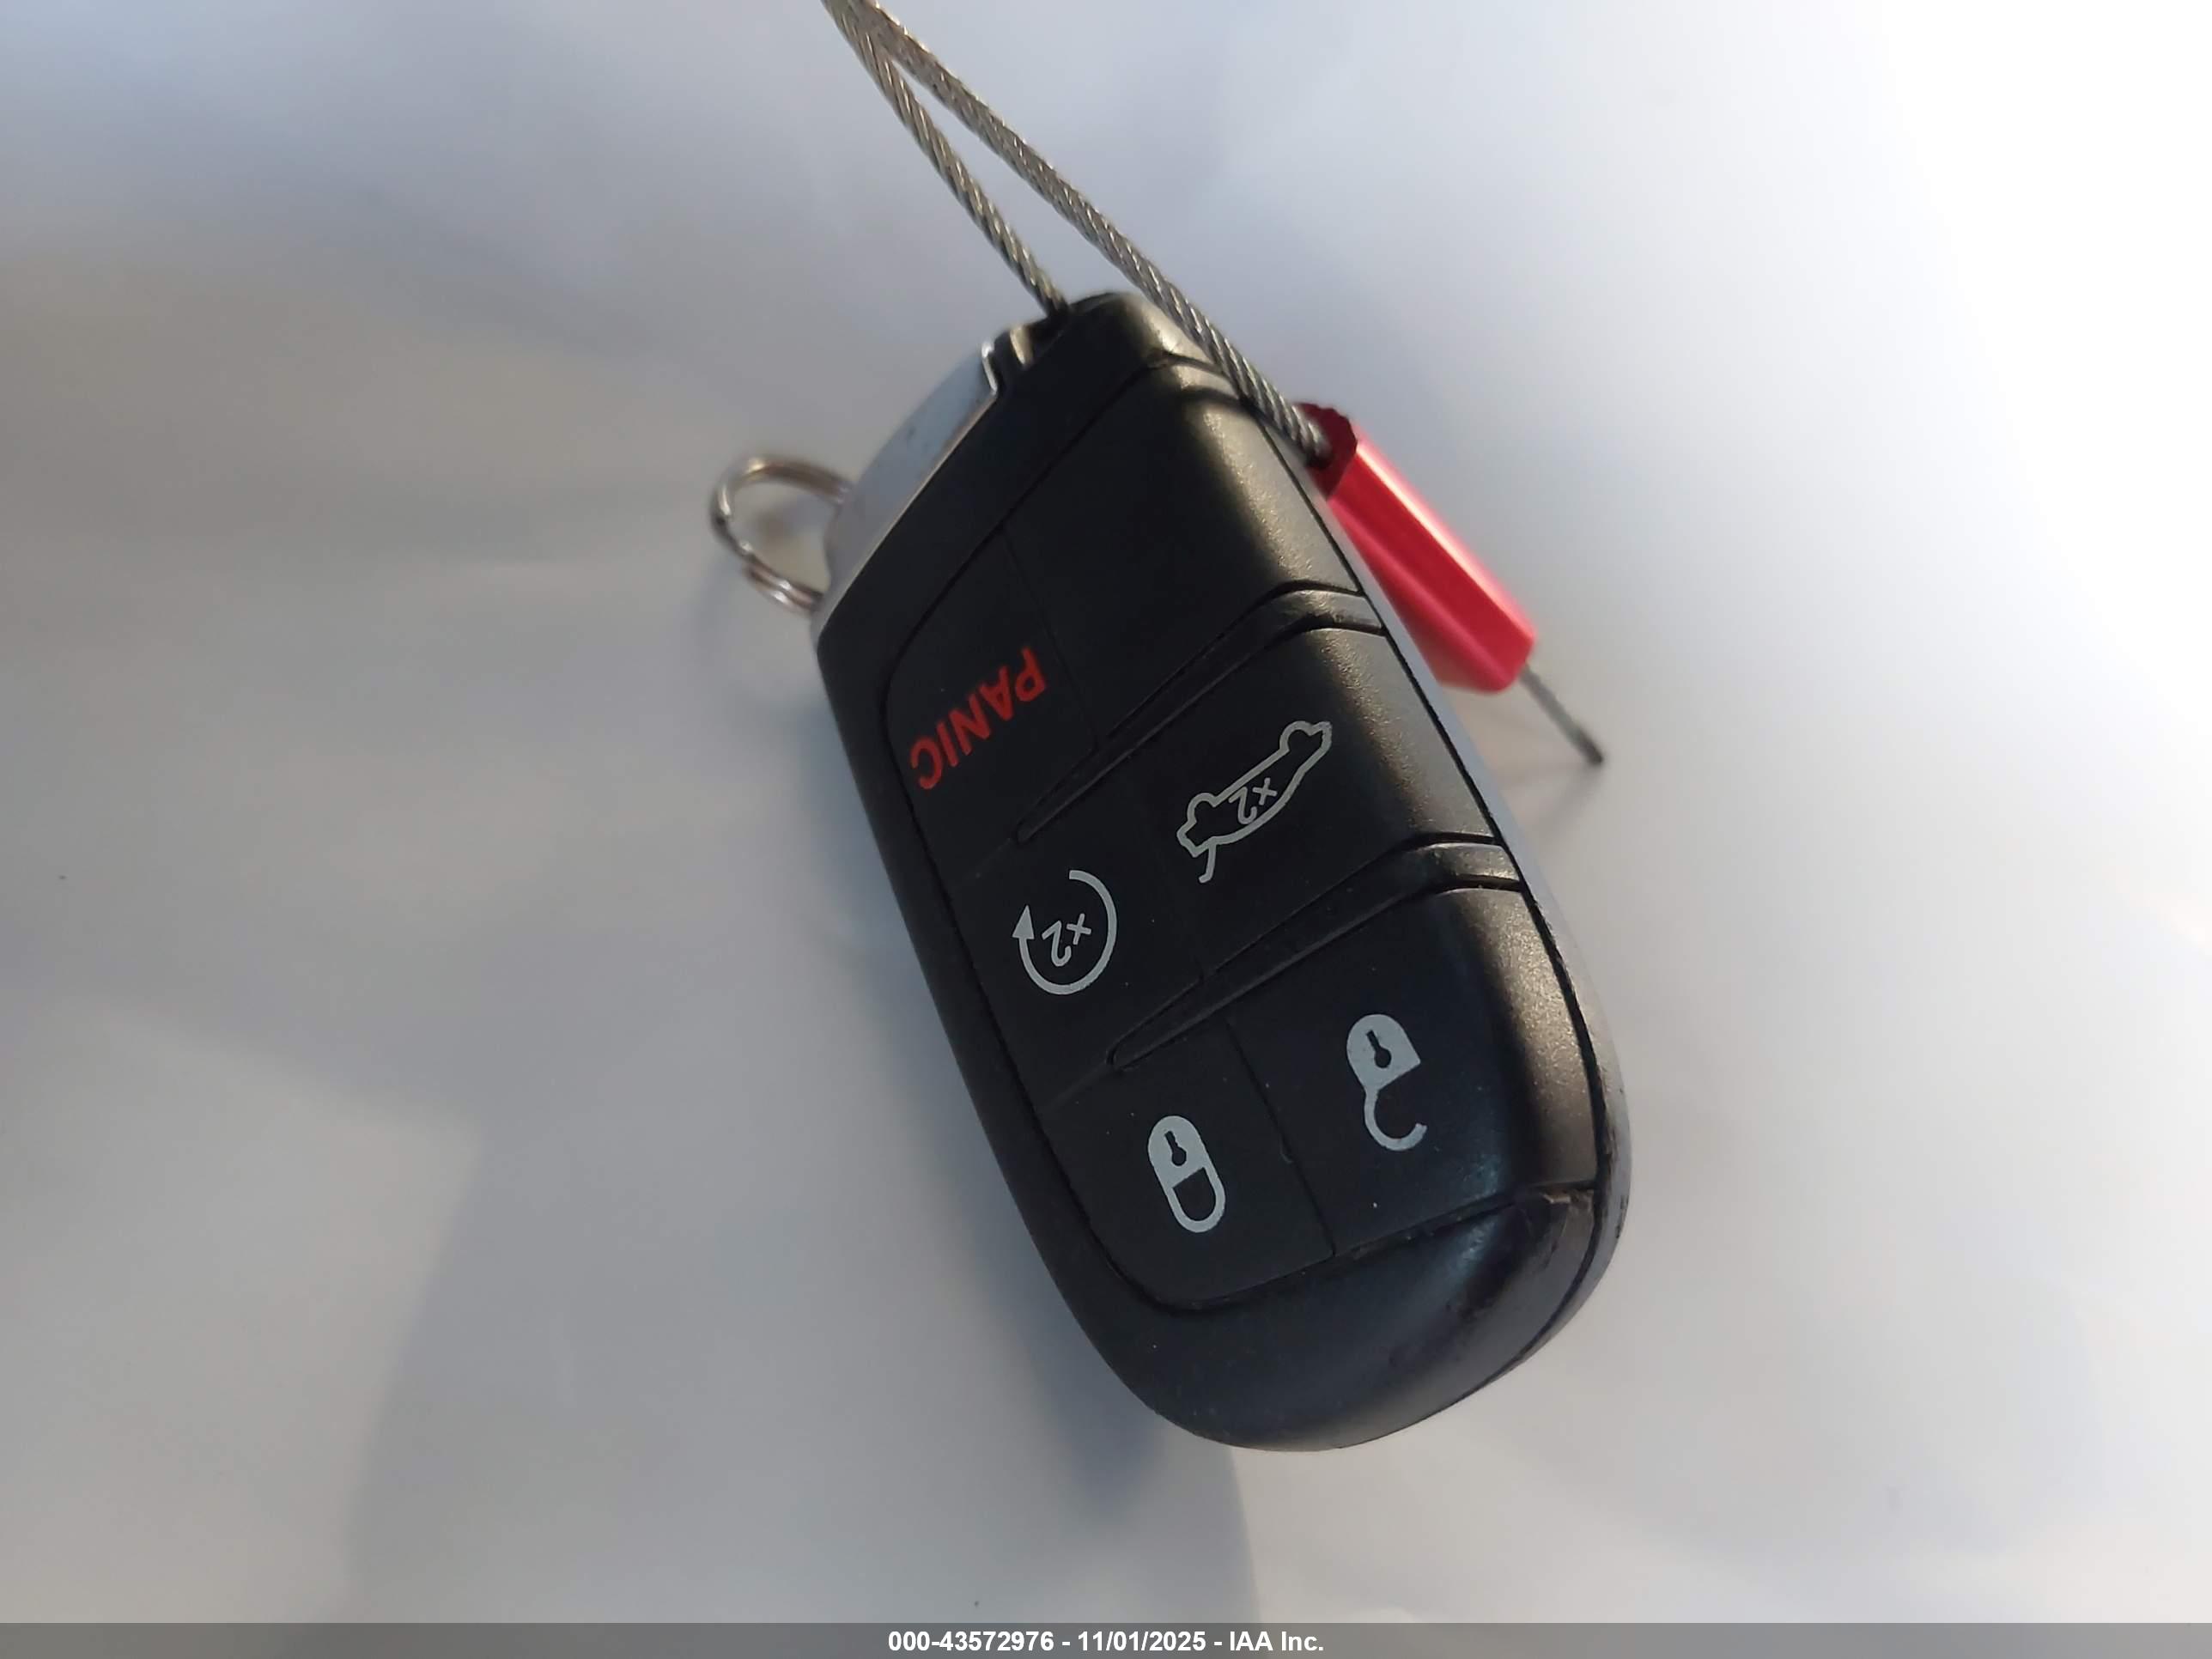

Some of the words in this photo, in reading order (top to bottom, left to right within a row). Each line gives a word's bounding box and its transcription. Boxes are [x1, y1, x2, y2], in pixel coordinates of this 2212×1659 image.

[910, 647, 1046, 789] PANIC
[1229, 778, 1277, 823] x2
[1042, 914, 1091, 967] x2
